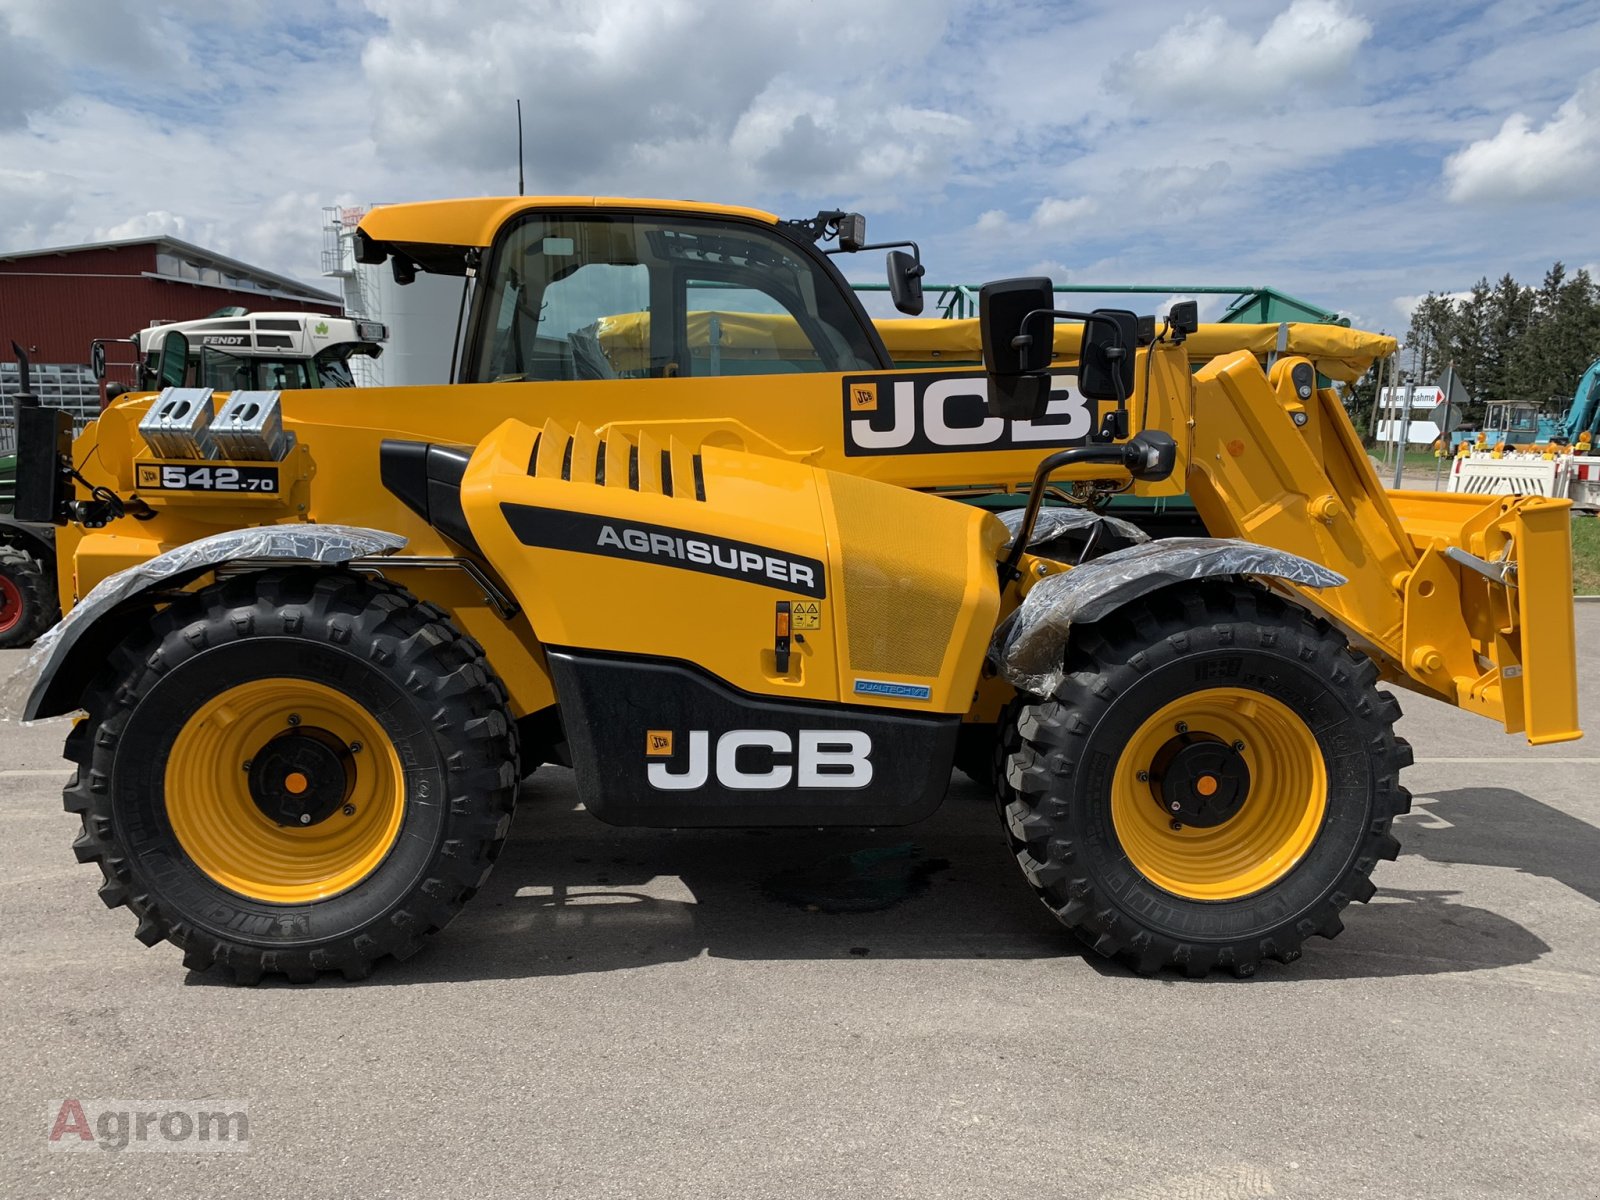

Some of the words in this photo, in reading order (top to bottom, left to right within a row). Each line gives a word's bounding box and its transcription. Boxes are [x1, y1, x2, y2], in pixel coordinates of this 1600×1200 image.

[203, 336, 244, 345] FENDT
[851, 375, 1092, 449] JCB
[855, 390, 873, 404] JCB
[597, 525, 815, 588] AGRISUPER
[647, 730, 873, 789] JCB
[653, 735, 668, 749] JCB
